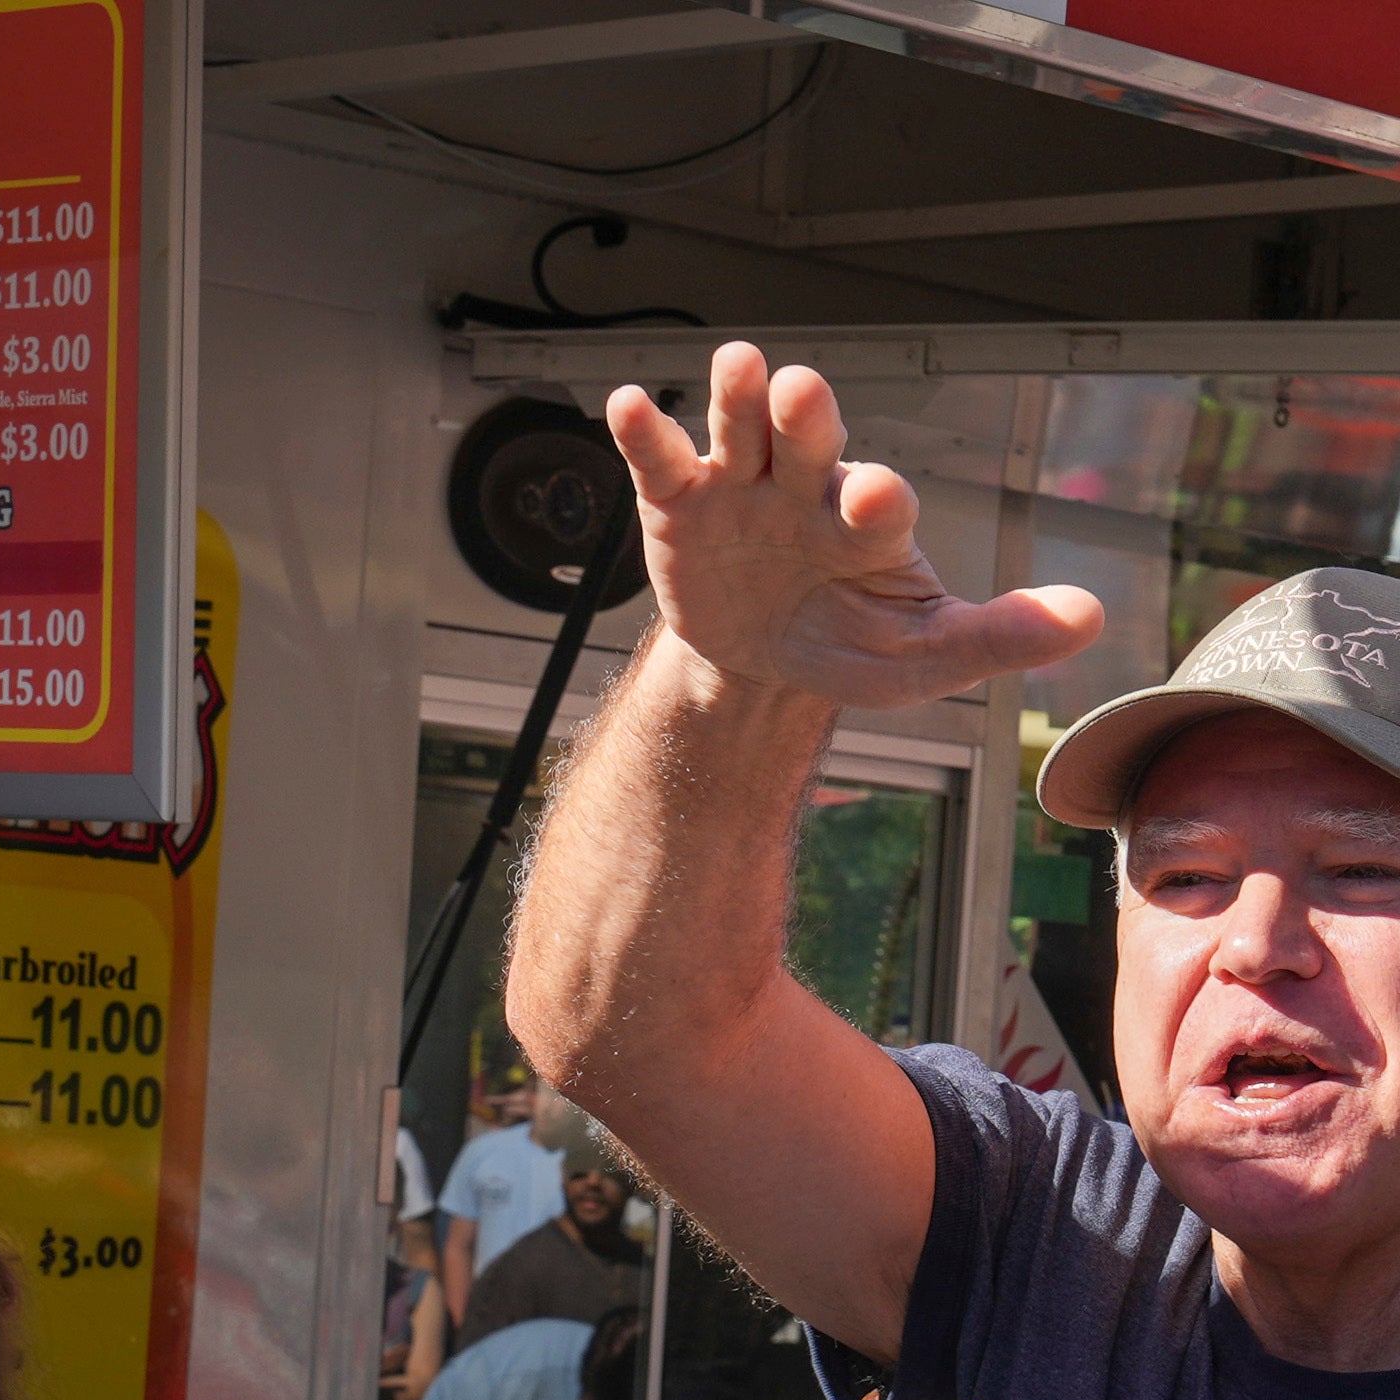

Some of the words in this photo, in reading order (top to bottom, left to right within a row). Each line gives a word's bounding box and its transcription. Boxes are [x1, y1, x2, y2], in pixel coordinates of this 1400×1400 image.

[3, 333, 91, 377] $3.00
[17, 390, 55, 408] Sierra
[58, 389, 88, 406] Mist
[1, 422, 89, 465] $3.00
[32, 995, 163, 1055] 11.00
[32, 1070, 163, 1129] 11.00
[39, 1228, 142, 1278] $3.00
